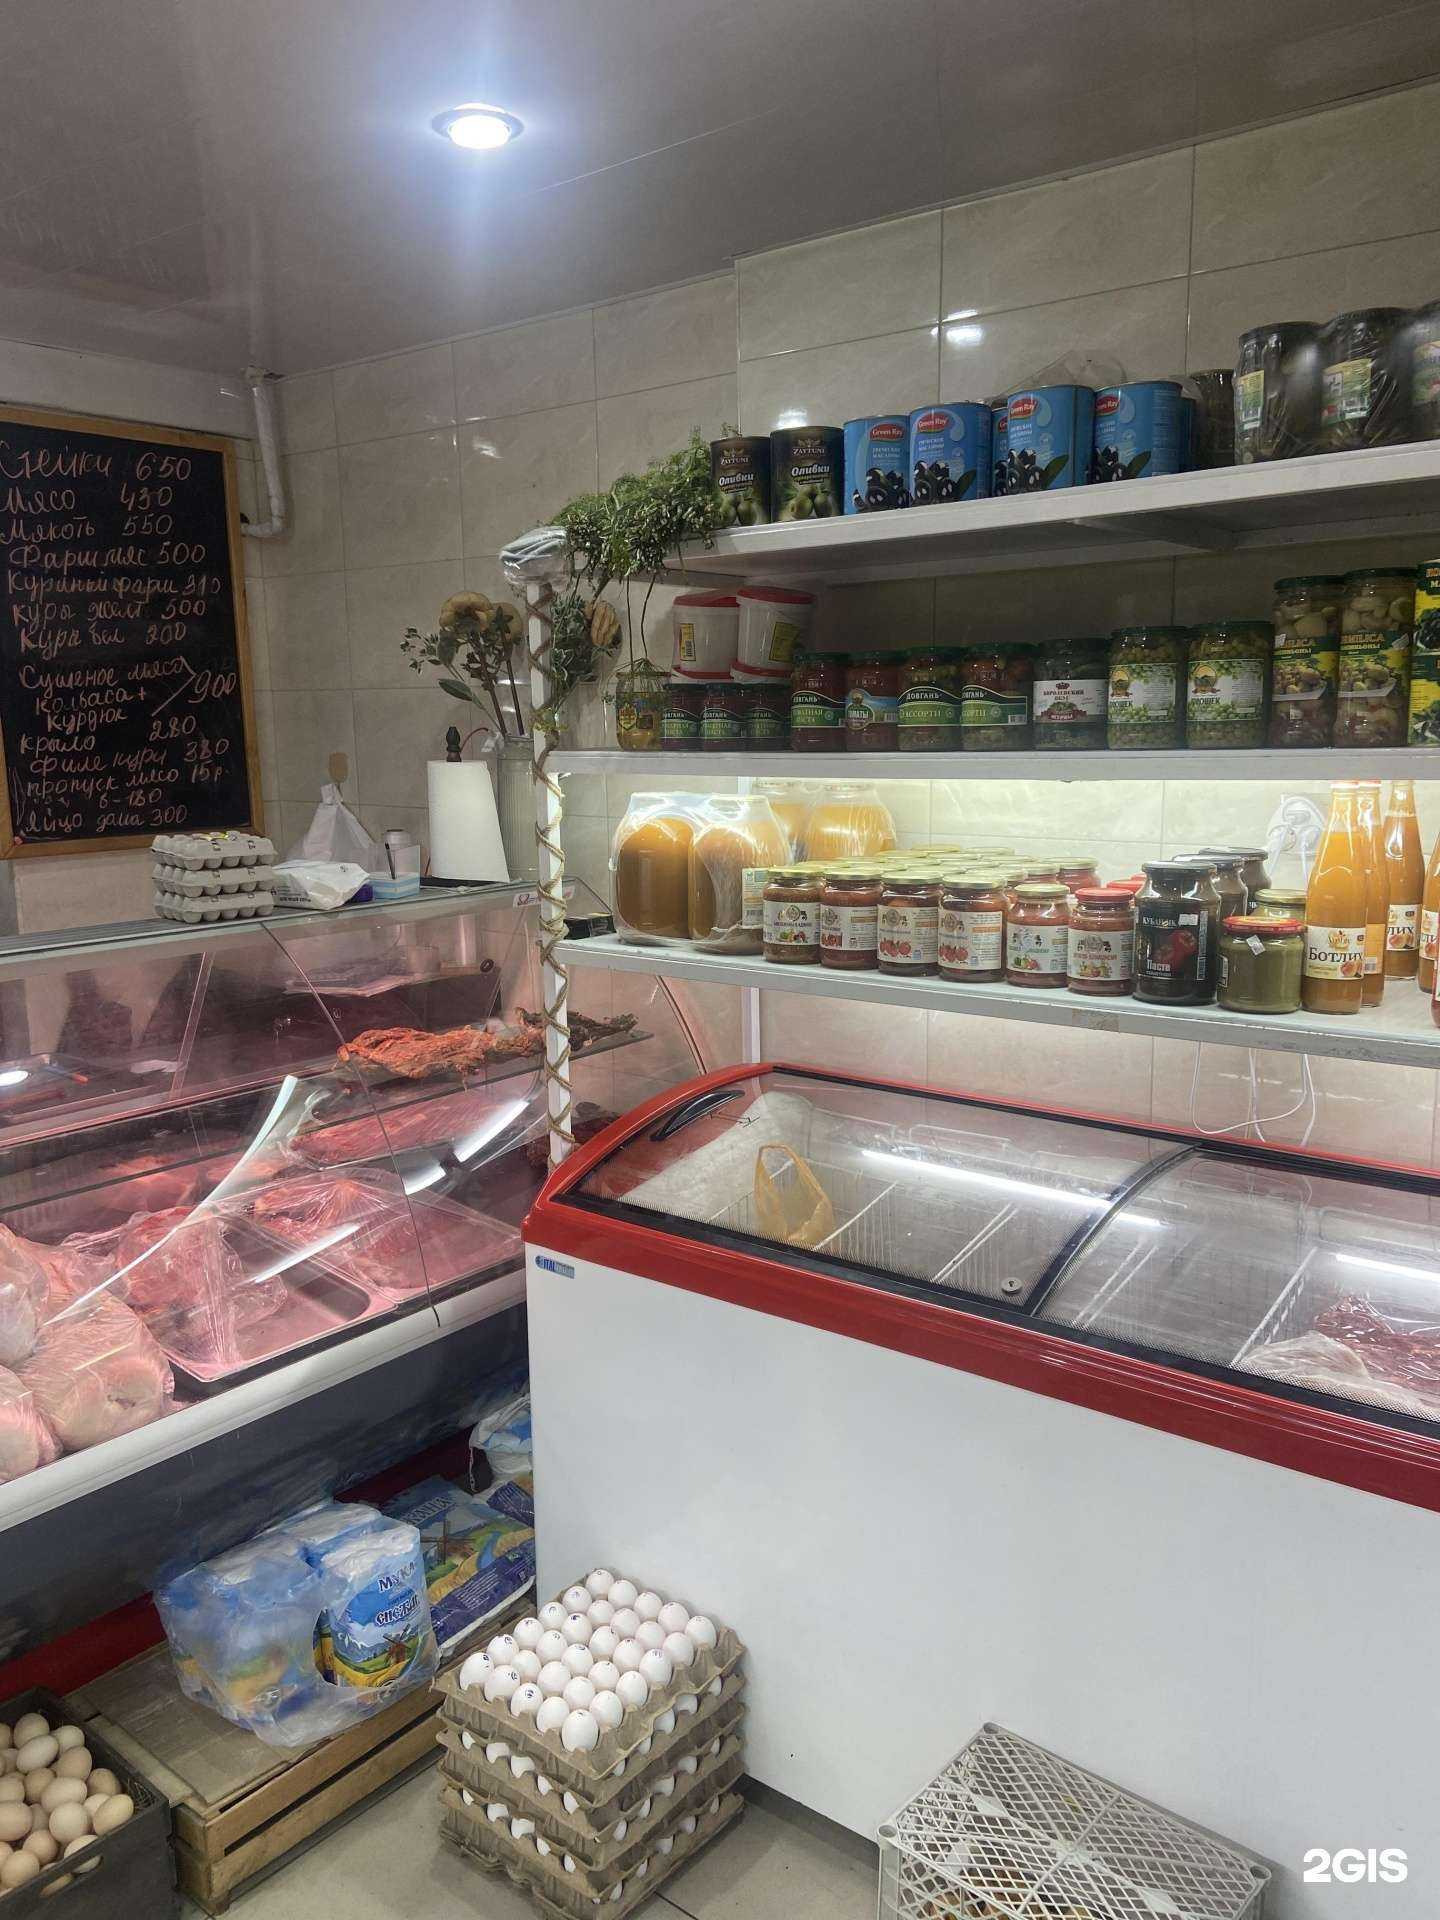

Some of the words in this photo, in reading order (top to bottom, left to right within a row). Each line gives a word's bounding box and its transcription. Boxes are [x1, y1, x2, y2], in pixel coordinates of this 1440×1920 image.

[135, 451, 192, 482] 650
[718, 472, 754, 486] Оливки
[791, 463, 830, 477] Оливки
[0, 487, 76, 515] Мясо
[0, 516, 95, 545] Мякоть
[121, 514, 173, 537] 550
[9, 544, 98, 575] Фарш
[157, 541, 206, 566] 500
[8, 570, 107, 602] Куриный
[160, 599, 206, 620] 500
[906, 692, 940, 700] ДОВГАНЬ
[149, 804, 188, 826] 300
